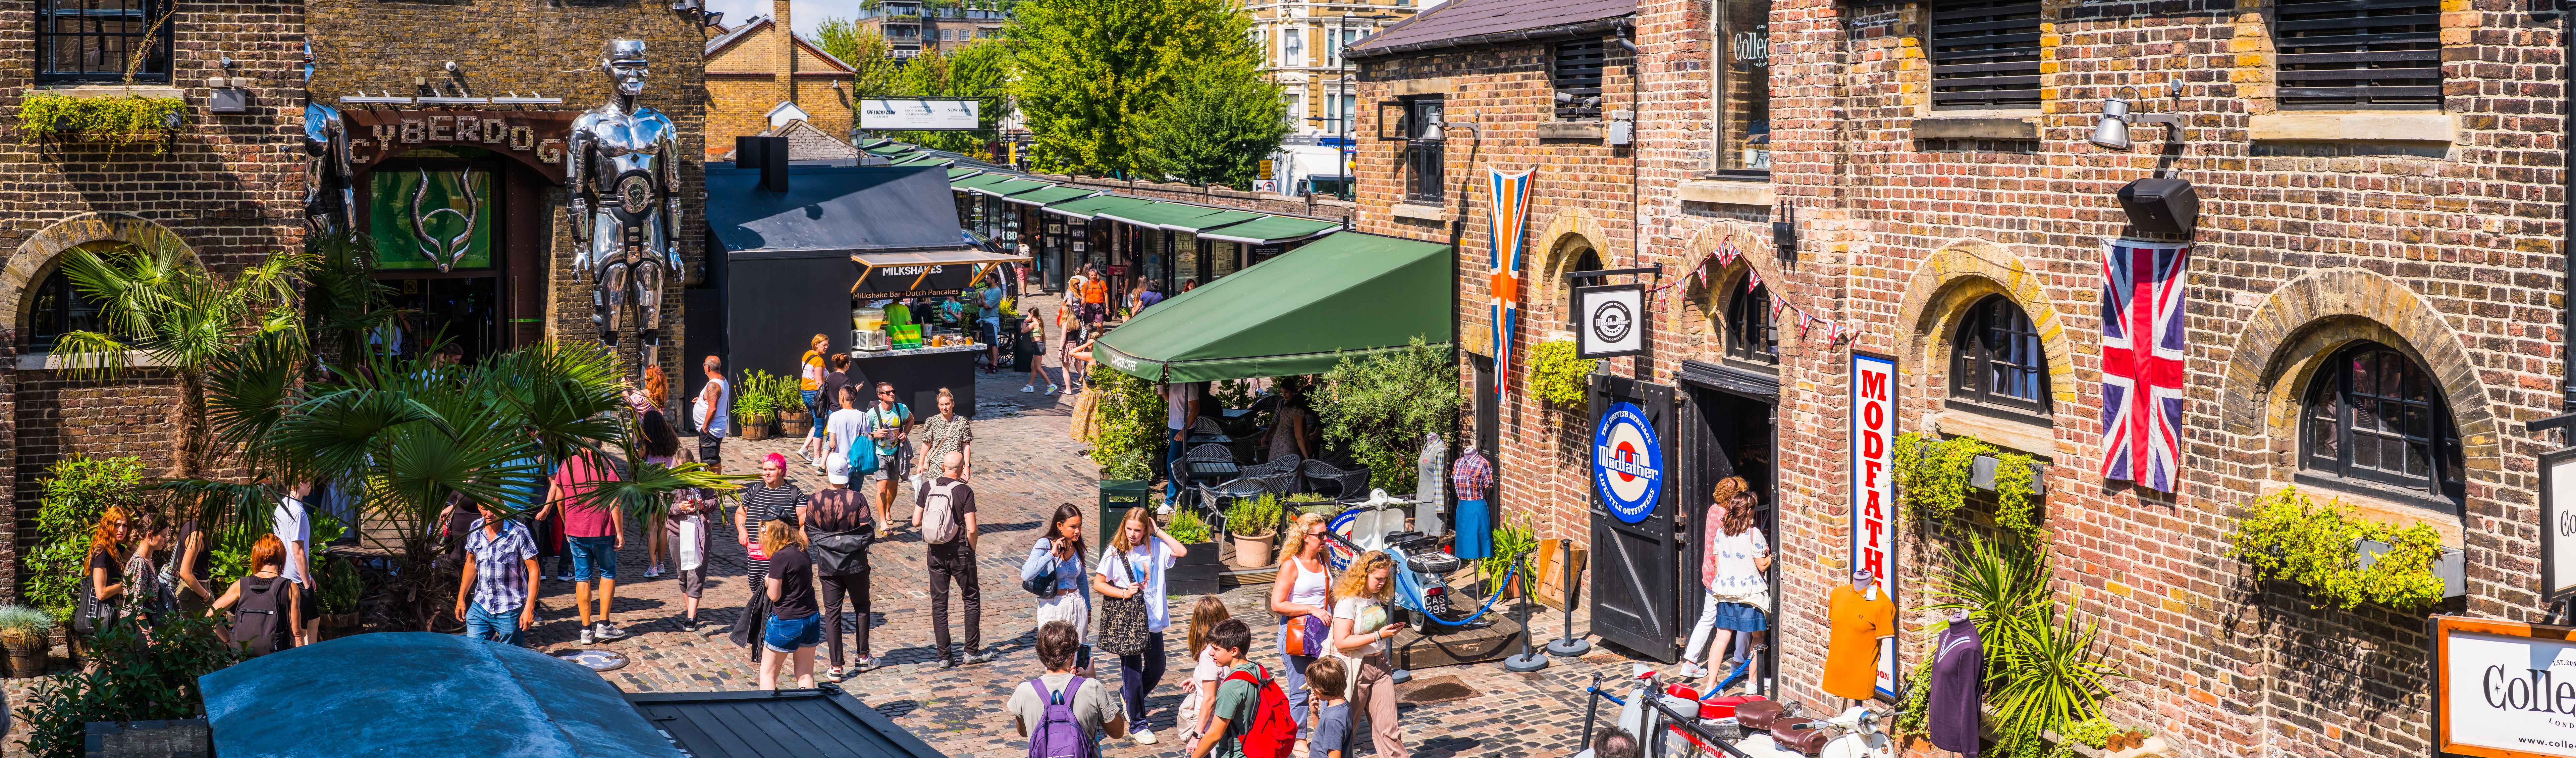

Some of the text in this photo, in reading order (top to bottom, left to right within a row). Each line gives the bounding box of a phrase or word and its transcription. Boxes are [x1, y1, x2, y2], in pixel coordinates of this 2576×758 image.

[349, 115, 561, 164] CYBERDOG
[1002, 231, 1017, 240] CBD
[1614, 303, 1627, 312] HERITAGE
[1595, 317, 1630, 327] Modfather
[893, 332, 920, 341] Lemonade
[1597, 327, 1628, 341] LIFESTYLE OUTFITTERS
[1112, 354, 1137, 371] CAMDEN COFFEE
[1601, 411, 1652, 445] THE BRITISH HERITAGE
[1598, 445, 1658, 481] Modfather
[1861, 369, 1887, 589] MODFATH
[1599, 472, 1655, 515] LIFESTYLE OUTFITTERS
[2560, 509, 2576, 537] Co
[1425, 595, 1445, 605] CAS
[1426, 604, 1446, 614] 295
[2483, 664, 2576, 716] Colle
[2548, 718, 2574, 729] LOND
[1665, 735, 1686, 756] John White
[2519, 737, 2576, 749] www.colle
